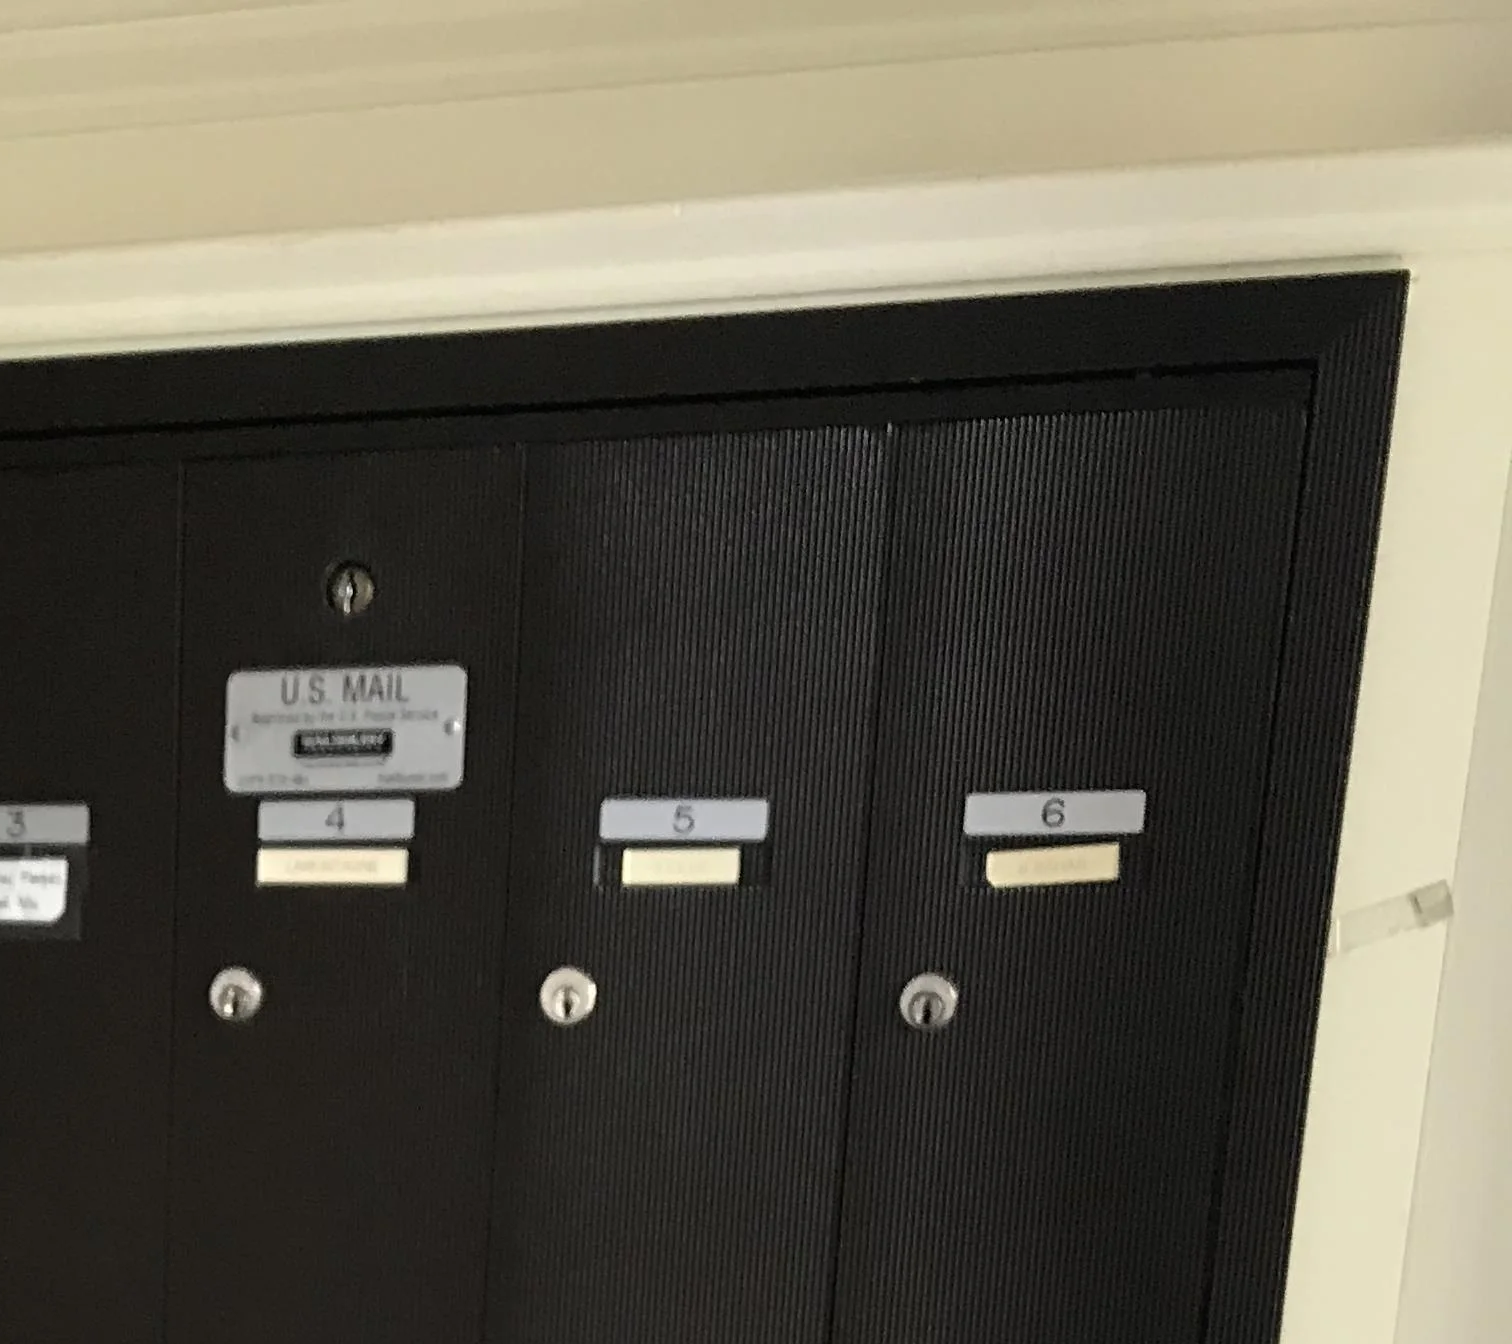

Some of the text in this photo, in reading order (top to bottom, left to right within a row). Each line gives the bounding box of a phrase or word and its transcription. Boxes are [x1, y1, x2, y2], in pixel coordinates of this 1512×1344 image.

[342, 672, 410, 704] MAIL
[6, 809, 27, 837] 3
[325, 805, 346, 831] 4
[672, 804, 695, 834] 5
[1041, 797, 1065, 828] 6
